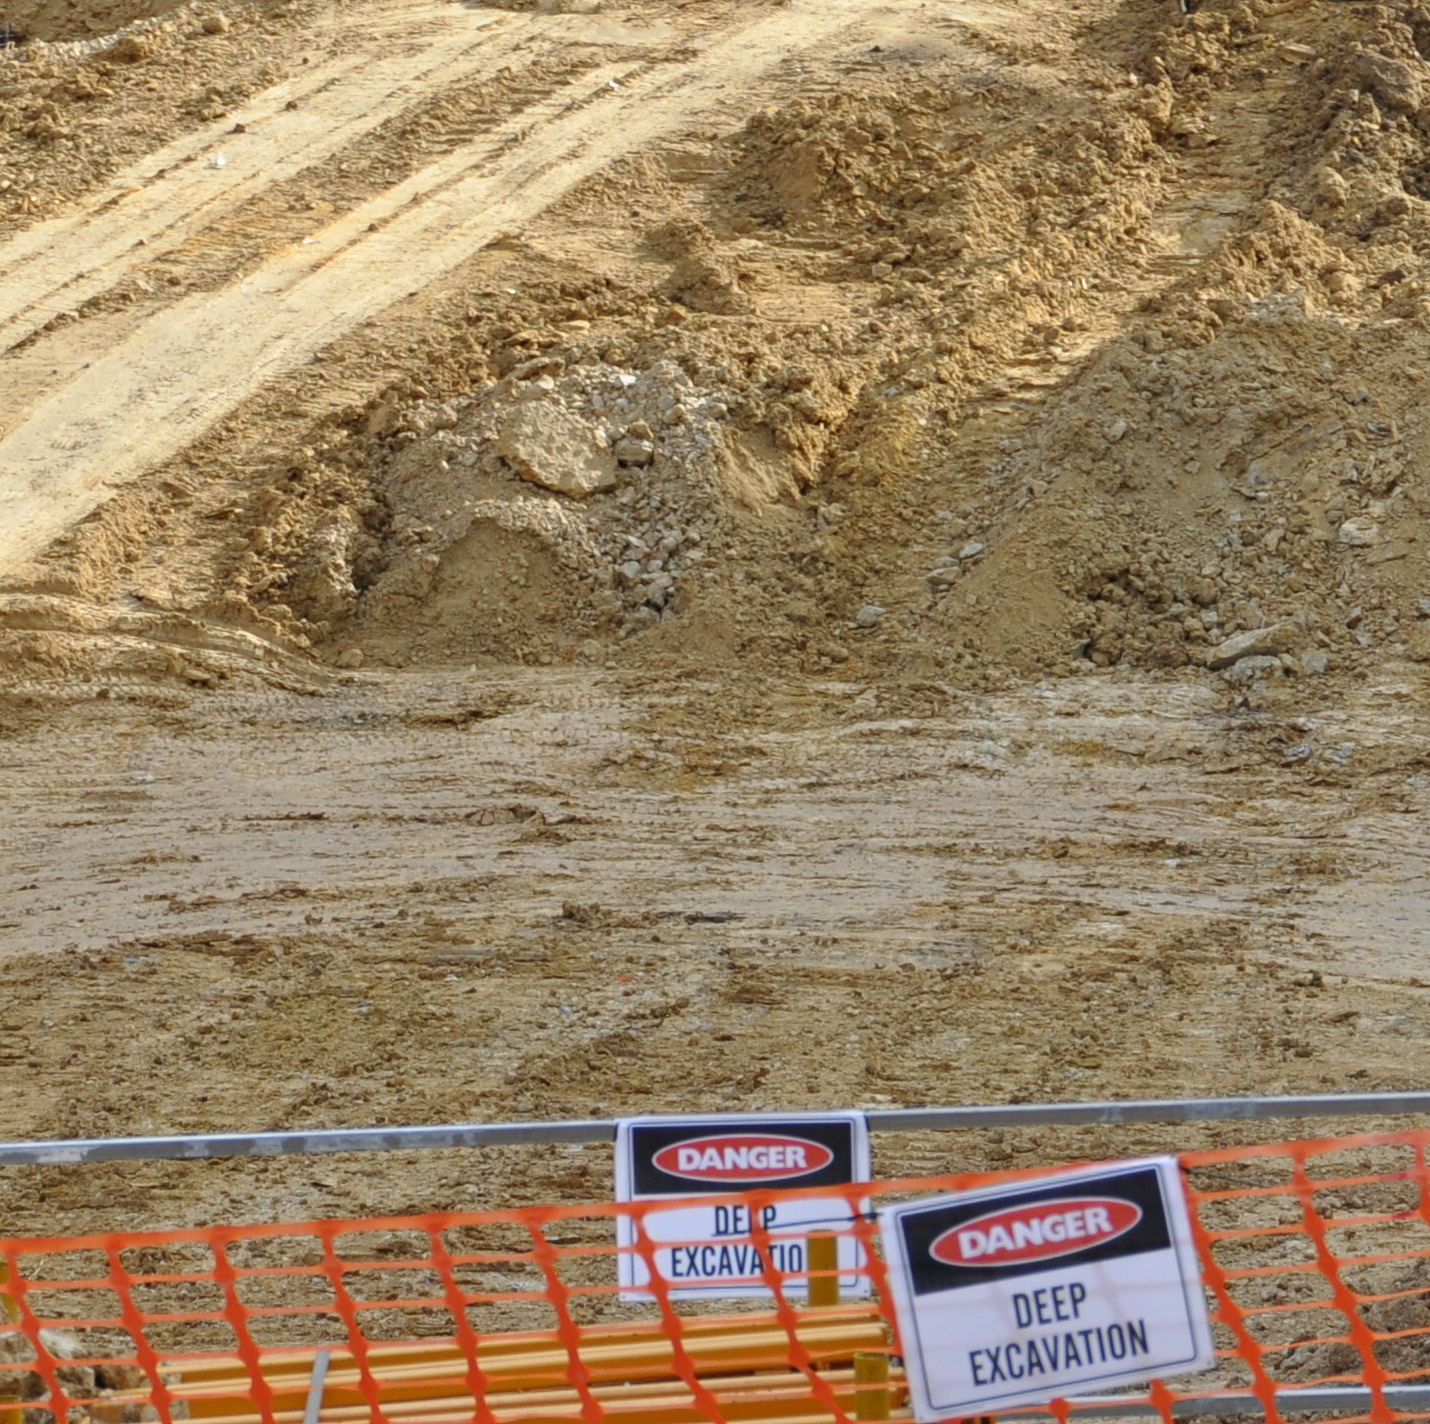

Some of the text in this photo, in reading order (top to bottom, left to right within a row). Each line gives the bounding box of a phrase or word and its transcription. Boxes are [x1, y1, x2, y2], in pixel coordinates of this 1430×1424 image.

[677, 1145, 808, 1172] DANGER
[957, 1206, 1114, 1260] DANGER
[1012, 1282, 1087, 1330] DEEP
[969, 1319, 1150, 1387] EXCAVATION
